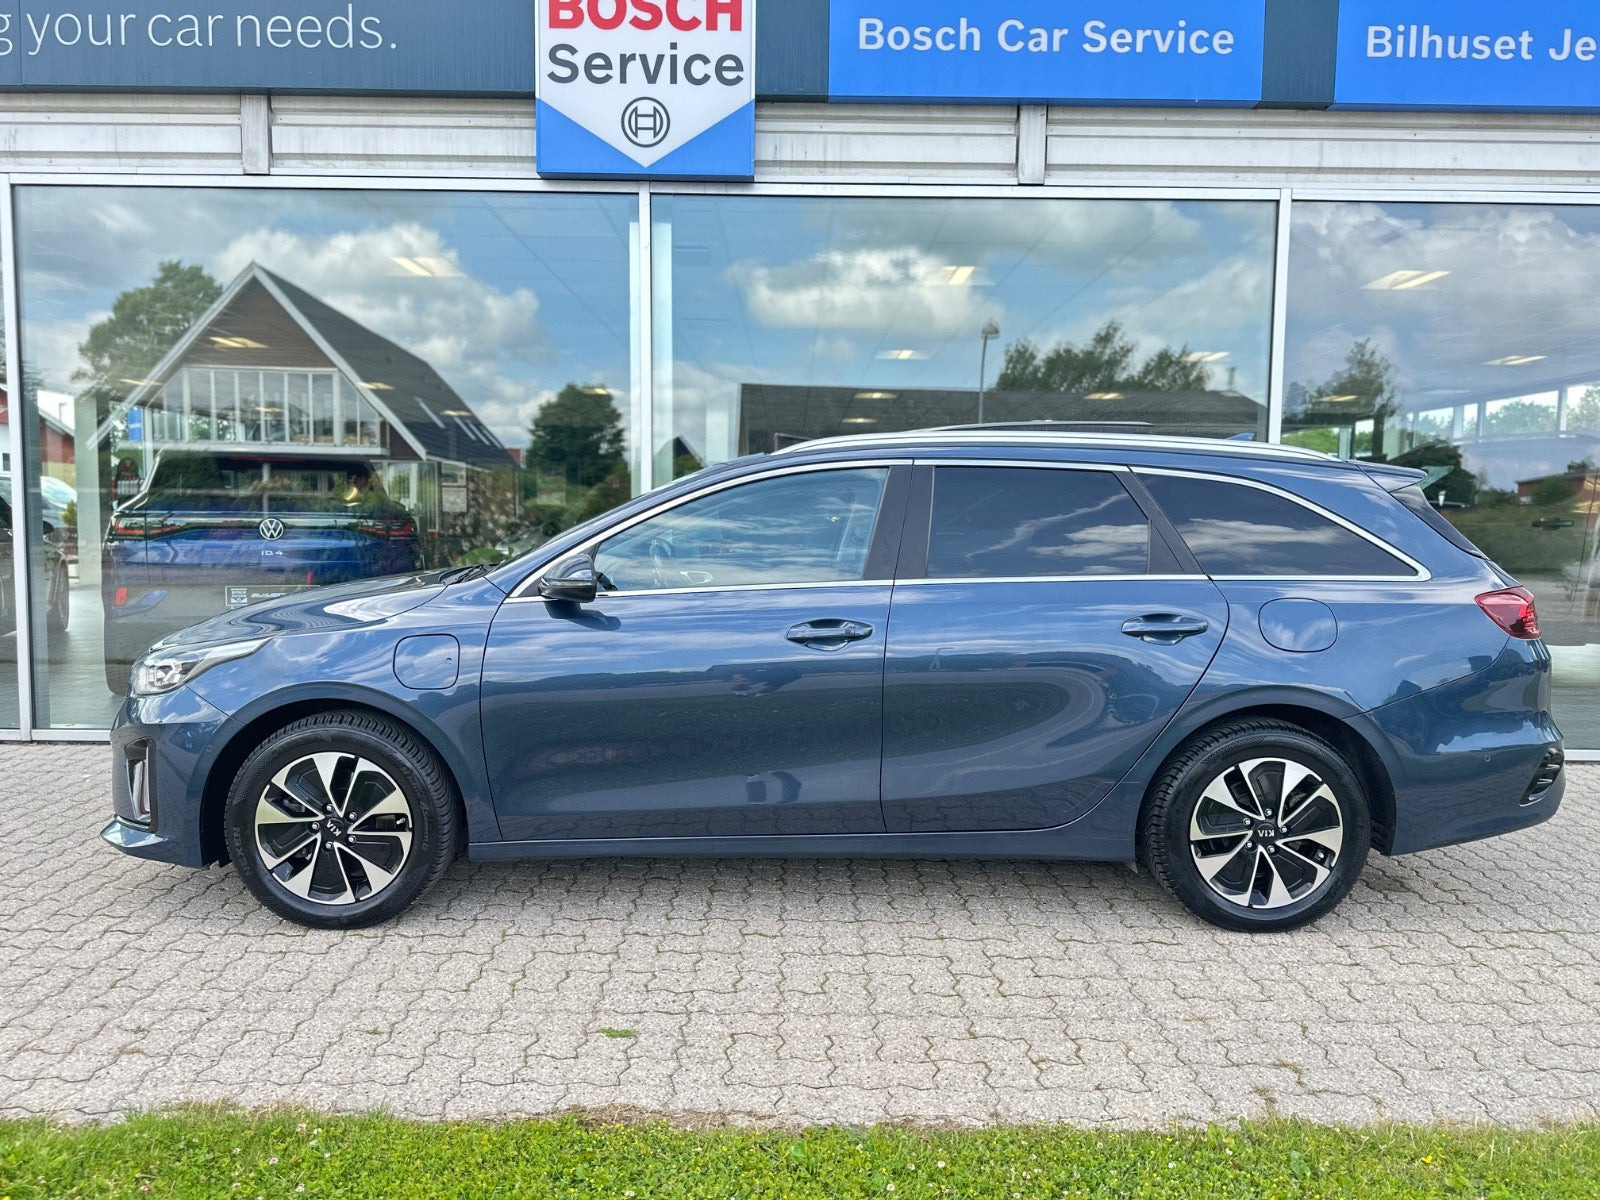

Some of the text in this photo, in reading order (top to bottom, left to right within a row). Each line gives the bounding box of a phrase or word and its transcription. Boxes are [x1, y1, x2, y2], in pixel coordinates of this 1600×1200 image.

[26, 13, 136, 55] your
[148, 14, 223, 46] car
[237, 3, 397, 48] needs.
[548, 0, 742, 31] BOSCH
[859, 17, 1235, 54] Bosch Car Service
[1367, 24, 1597, 61] Bilhuset Je
[547, 42, 744, 86] Service
[1257, 829, 1275, 838] KIA
